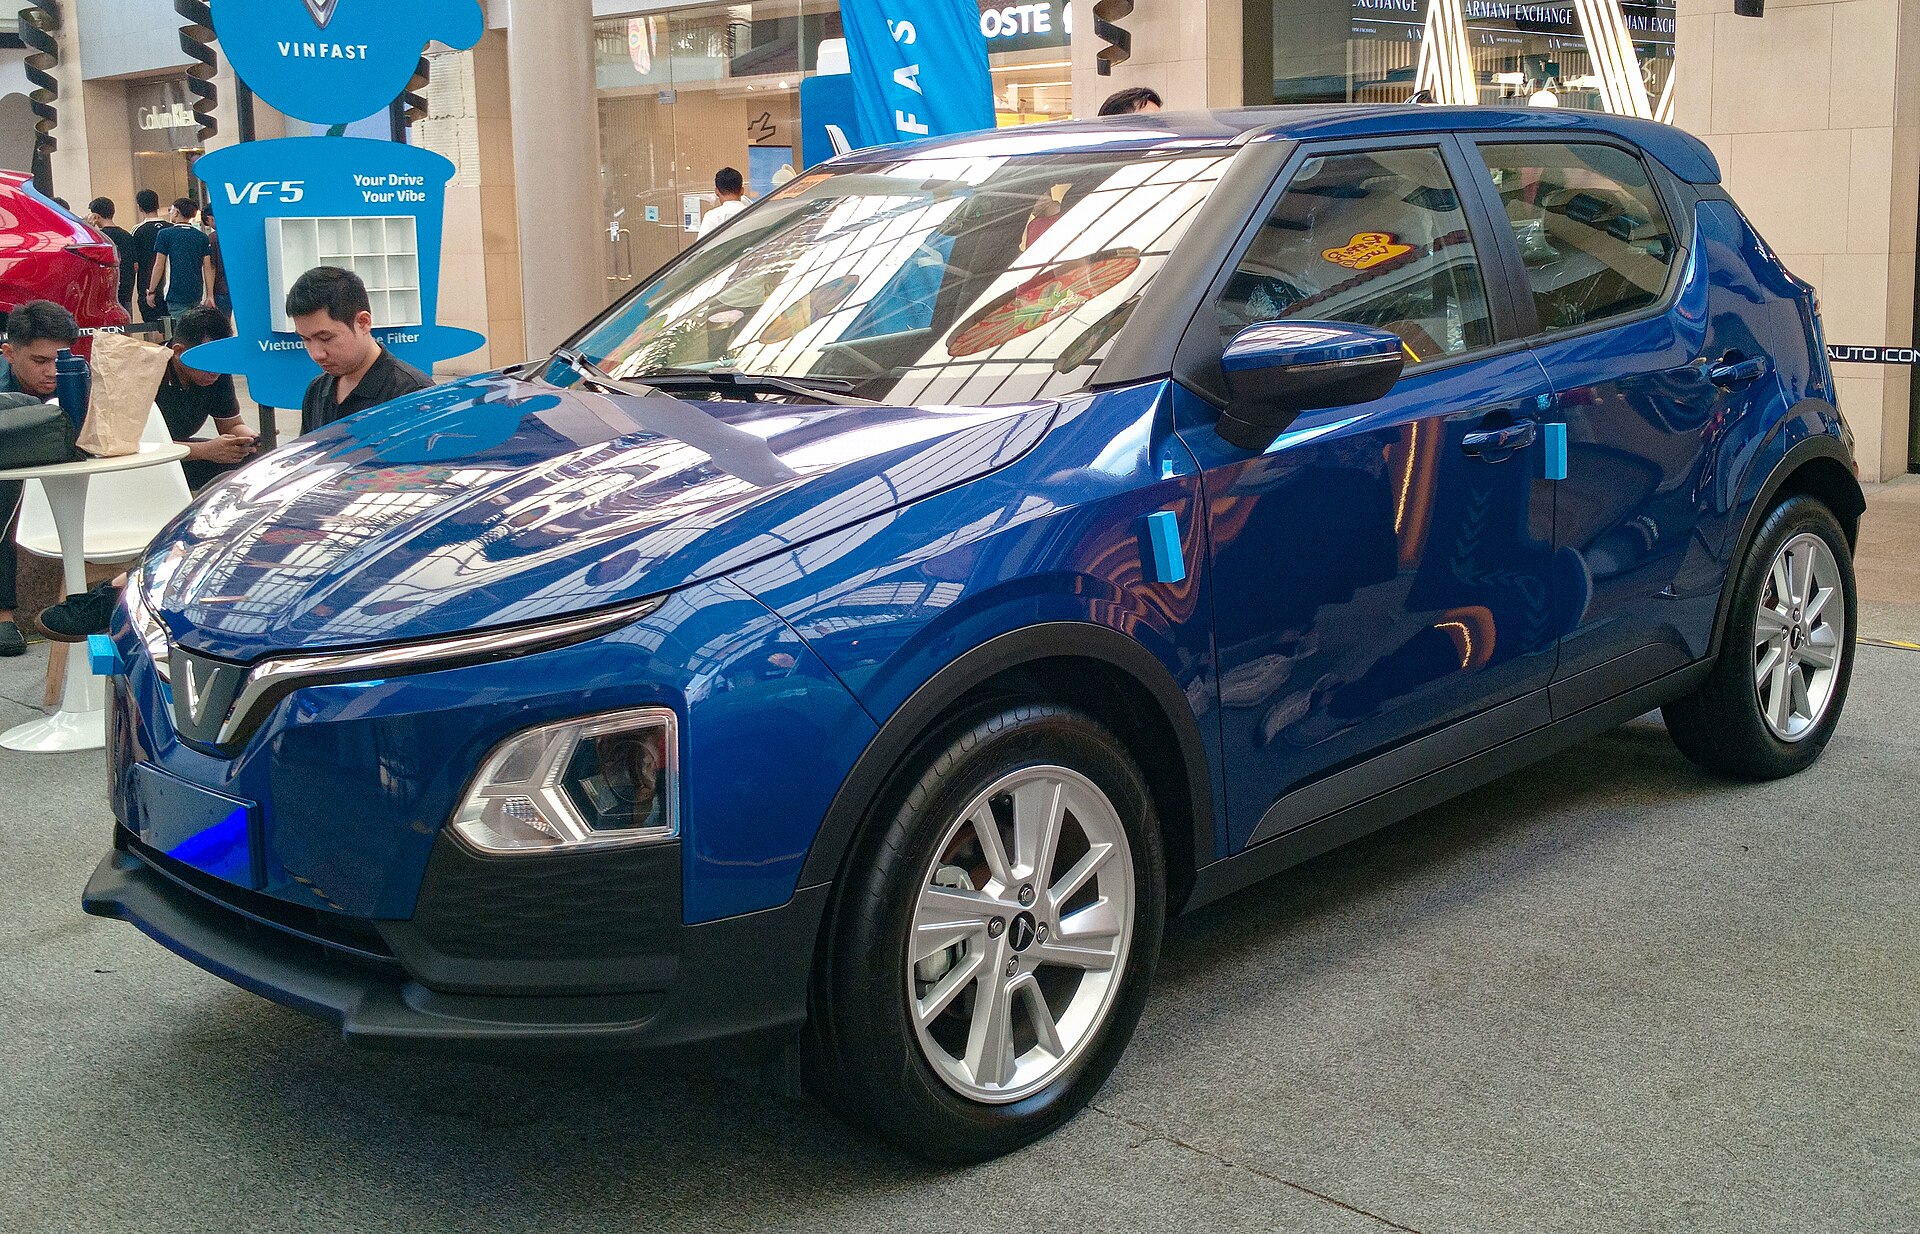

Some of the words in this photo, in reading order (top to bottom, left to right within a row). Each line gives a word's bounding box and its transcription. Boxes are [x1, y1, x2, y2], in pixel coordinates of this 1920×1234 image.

[1465, 1, 1510, 18] ARMANI
[1515, 5, 1573, 25] EXCHANGE
[277, 41, 368, 60] VINFAST
[353, 174, 386, 187] Your
[388, 173, 424, 186] Drive
[362, 190, 395, 203] Your
[396, 189, 426, 202] Vibe
[387, 333, 420, 344] Filter
[1827, 346, 1877, 361] AUTO
